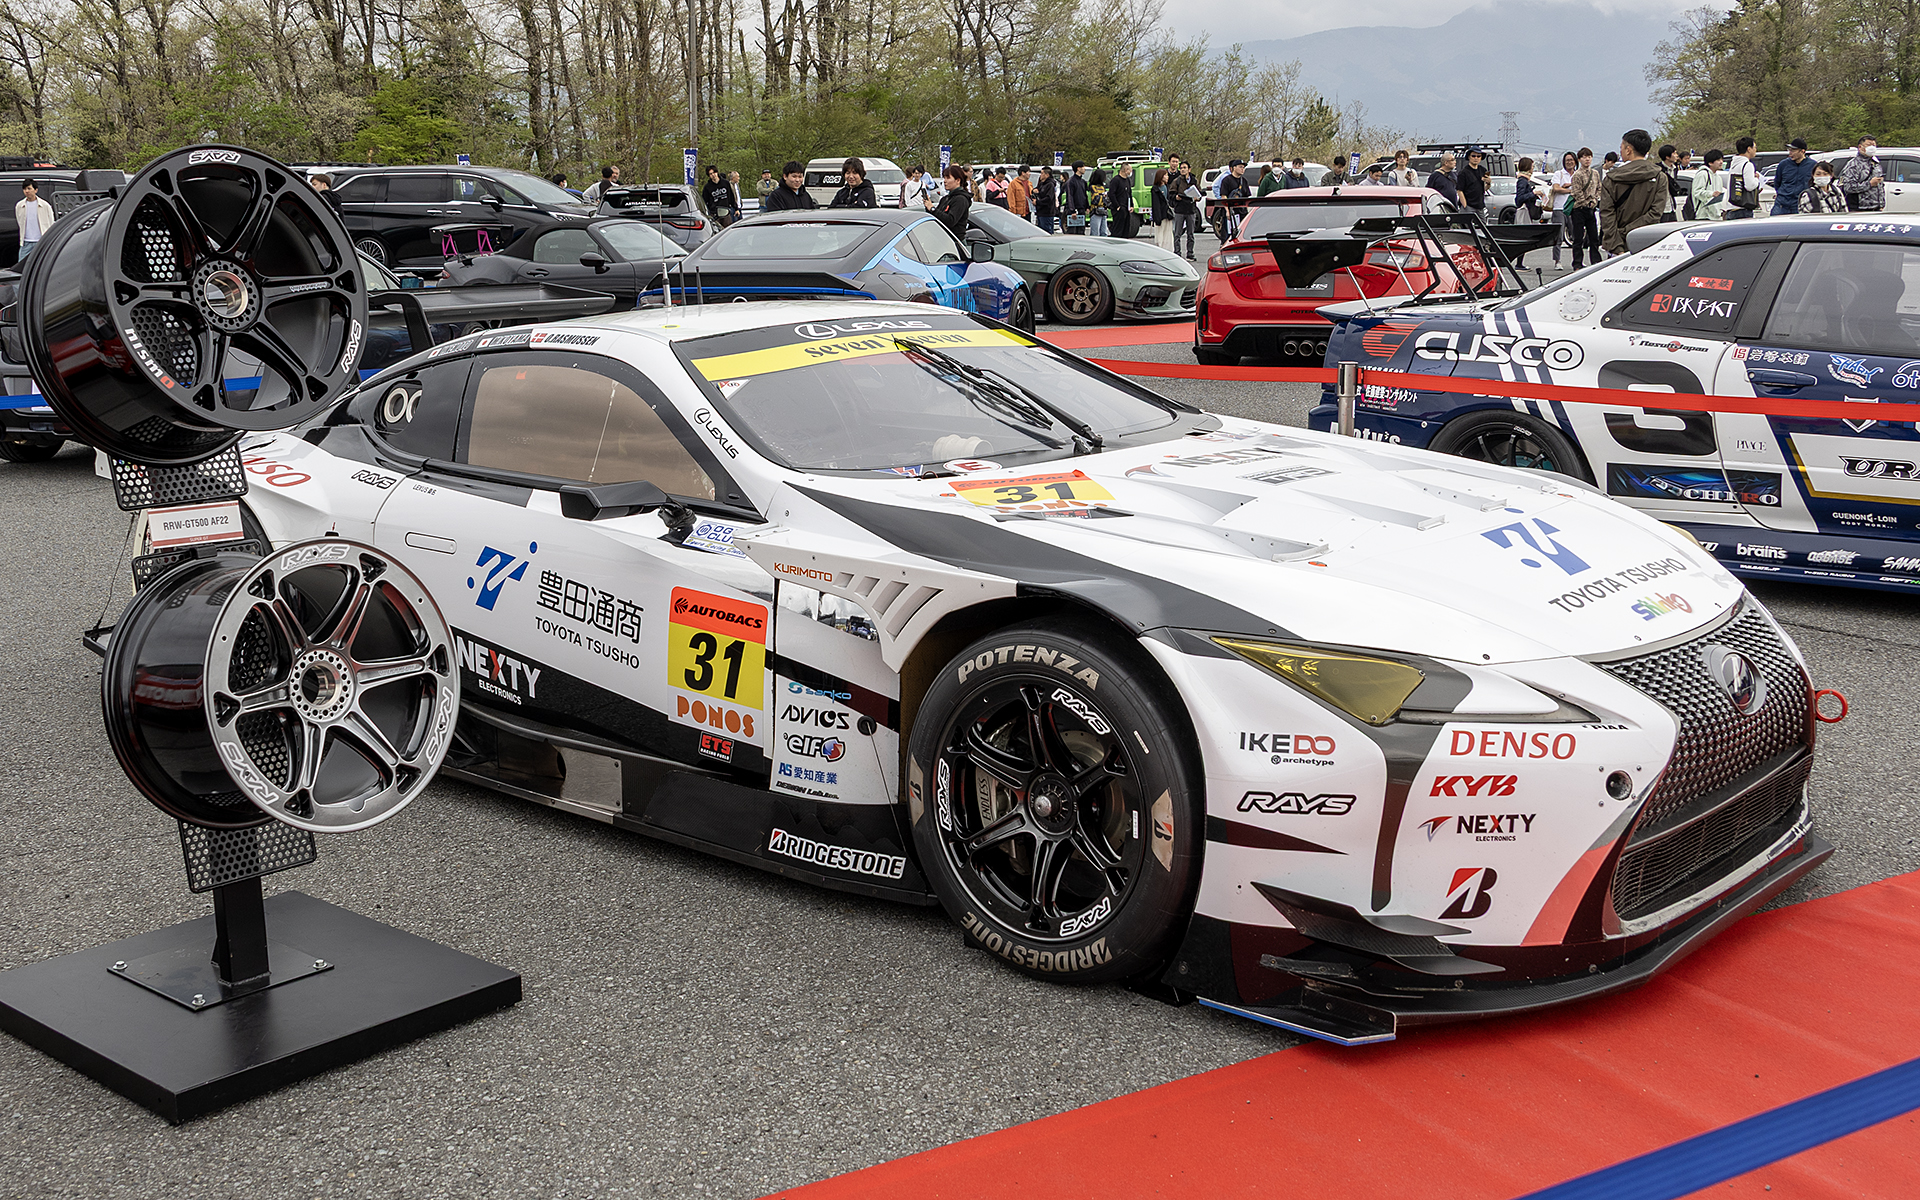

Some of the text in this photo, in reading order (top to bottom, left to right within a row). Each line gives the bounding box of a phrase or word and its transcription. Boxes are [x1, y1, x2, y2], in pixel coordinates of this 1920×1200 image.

[832, 320, 932, 333] LEXUS
[124, 328, 175, 389] nismo
[341, 319, 362, 373] RAYS
[804, 333, 973, 358] seven seven
[1414, 331, 1585, 372] CUSCO
[704, 421, 740, 460] LEXUS
[351, 469, 397, 490] RAYS
[993, 482, 1075, 504] 31
[163, 516, 229, 531] RRW-GT500 AF22
[281, 543, 350, 571] RAYS
[1736, 542, 1789, 560] brains
[774, 562, 833, 583] KURIMOTO
[1548, 558, 1687, 612] TOYOTA TSUSHO
[537, 569, 645, 645] 豊田通商
[688, 604, 763, 629] AUTOBACS
[535, 616, 640, 669] TOYOTA TSUSHO
[456, 635, 541, 698] NEXTY
[684, 632, 746, 700] 31
[957, 645, 1100, 691] POTENZA
[478, 679, 522, 705] ELECTRONICS
[426, 687, 454, 765] RAYS
[677, 695, 754, 738] PONOS
[781, 704, 850, 729] ADVICS
[1051, 688, 1111, 735] RAYS
[701, 734, 732, 752] ETS
[788, 735, 823, 757] elf
[1239, 732, 1336, 755] IKEDO
[1450, 730, 1576, 760] DENSO
[222, 741, 280, 802] RAYS
[794, 766, 838, 785] 愛知産業
[1282, 757, 1335, 767] archetype
[937, 758, 952, 831] RAYS
[978, 777, 992, 821] ENDLESS
[1429, 775, 1518, 797] KYB
[1236, 791, 1356, 815] RAYS
[1456, 814, 1537, 834] NEXTY
[768, 828, 906, 879] BRIDGESTONE
[1060, 896, 1112, 937] RAYS
[960, 911, 1113, 973] BRIDGESTONE
